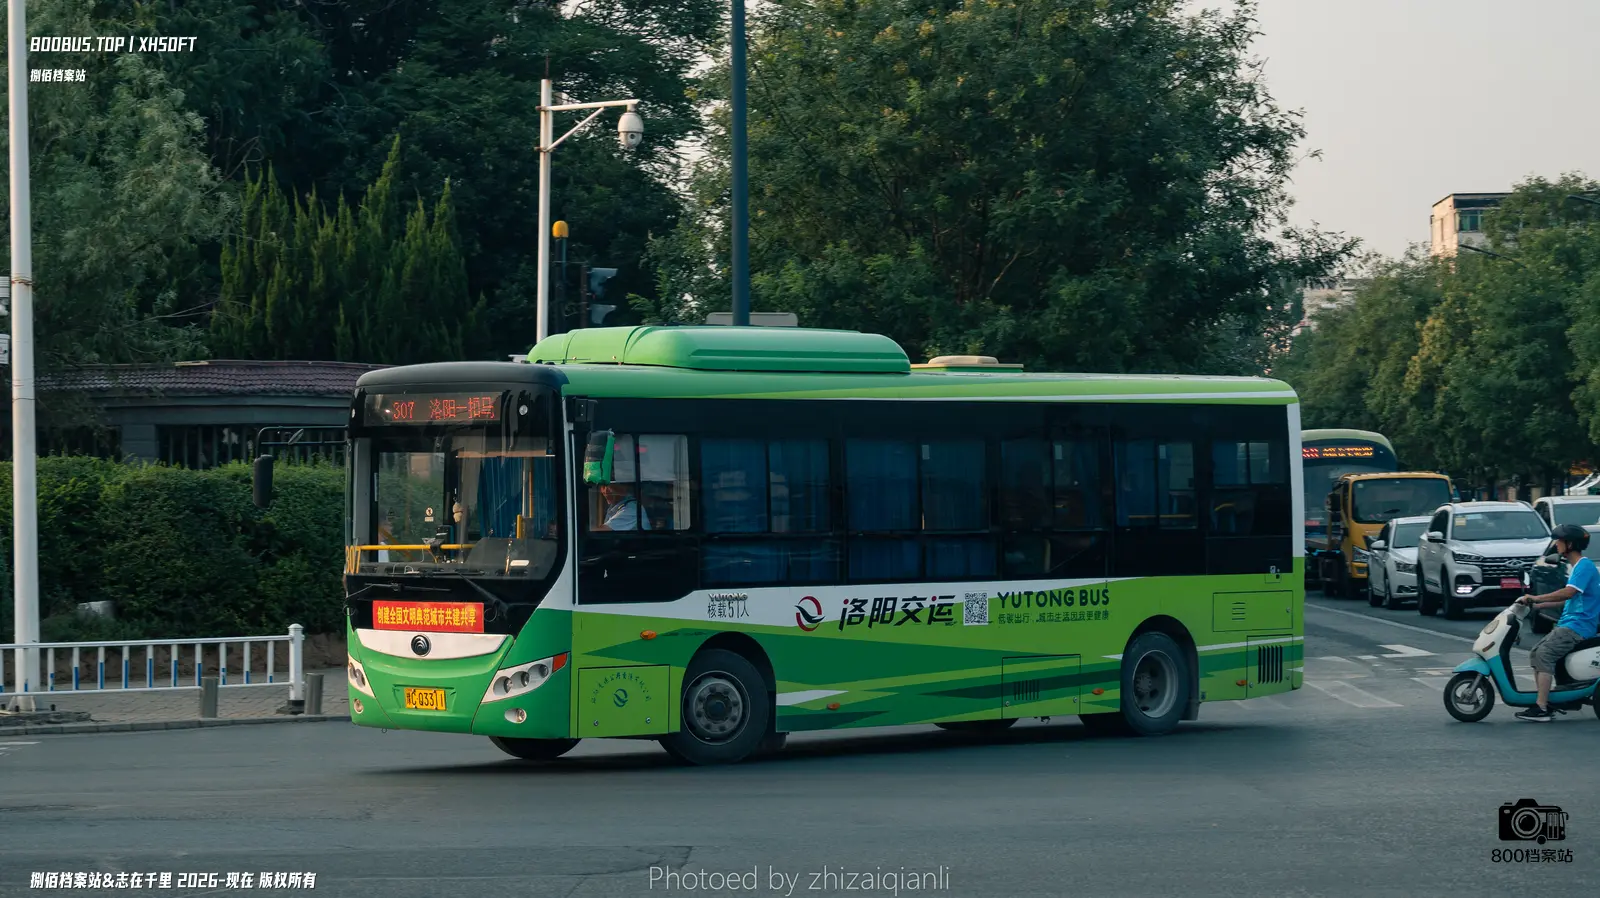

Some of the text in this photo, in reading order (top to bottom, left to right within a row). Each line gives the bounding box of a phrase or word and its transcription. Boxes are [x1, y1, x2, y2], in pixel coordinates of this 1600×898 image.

[393, 401, 415, 419] 307
[997, 588, 1110, 609] YUTONG BUS
[838, 595, 956, 632] 洛阳交运
